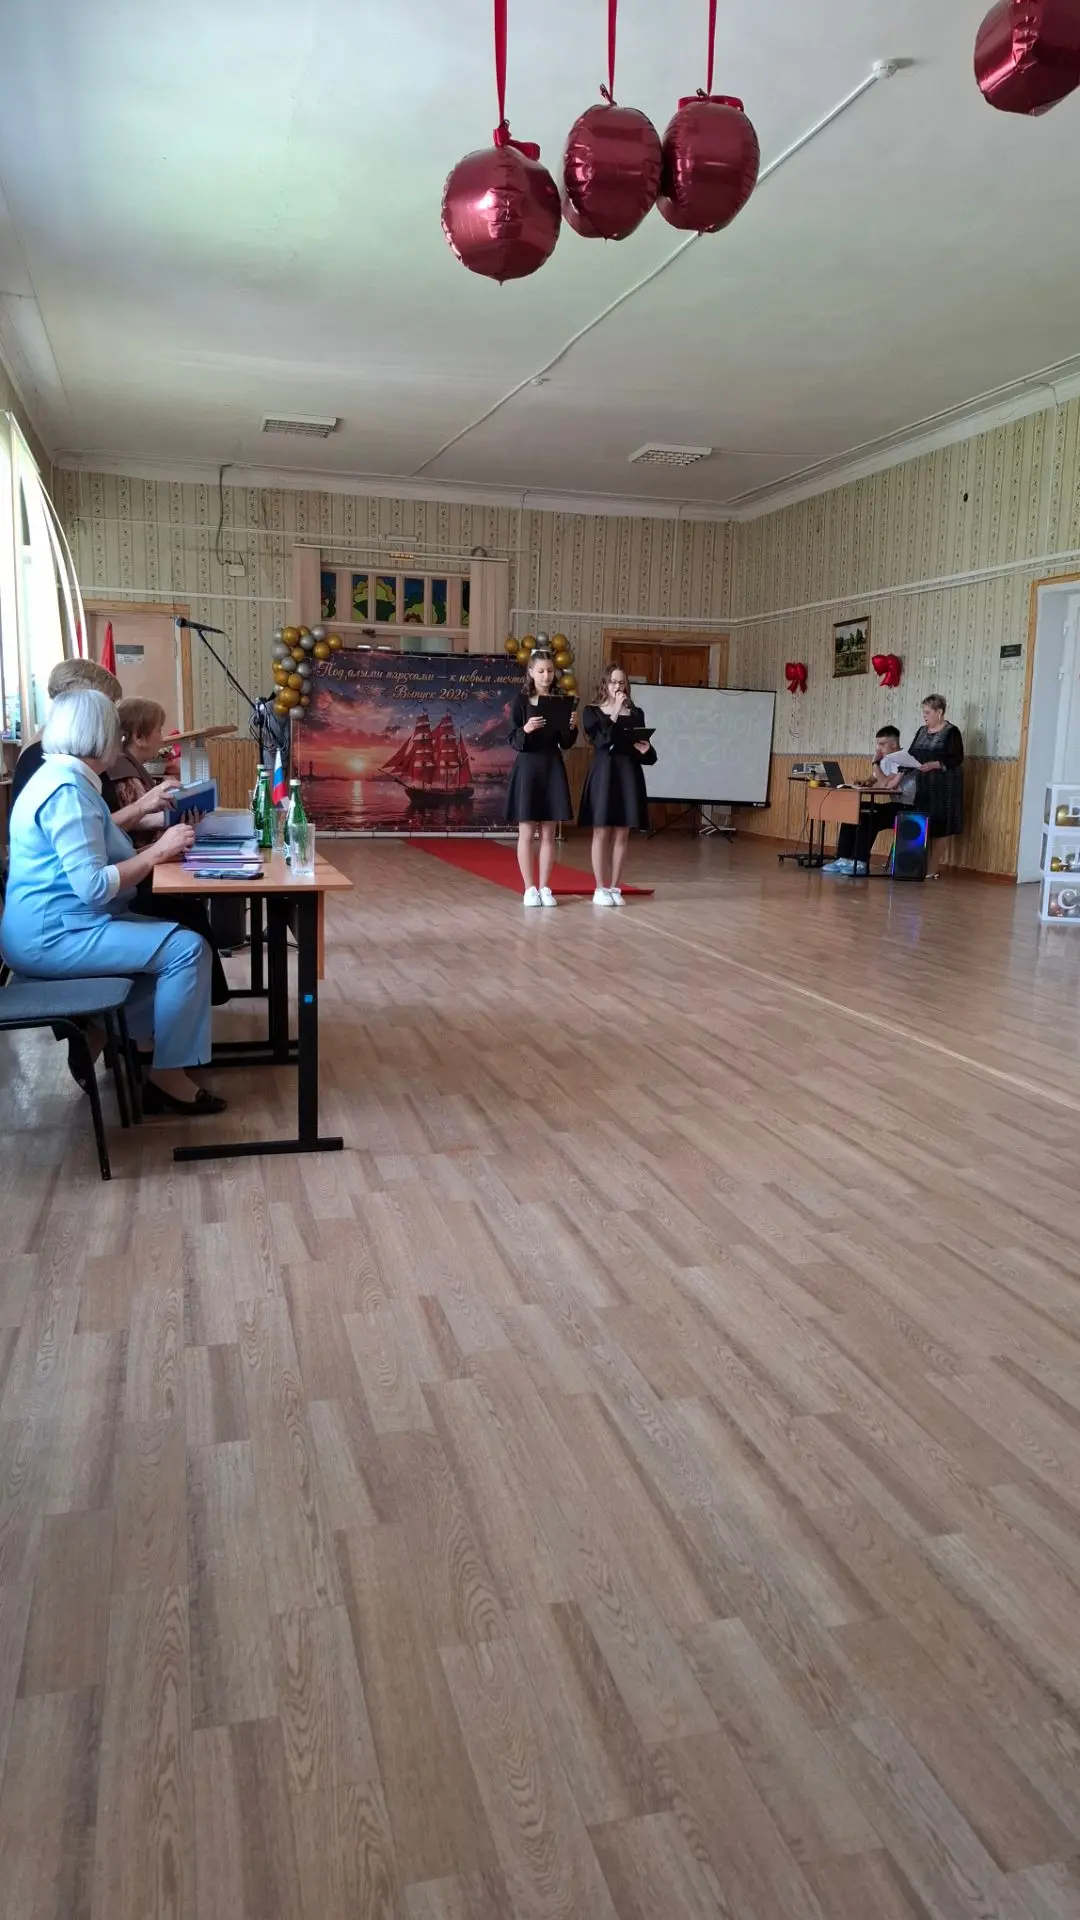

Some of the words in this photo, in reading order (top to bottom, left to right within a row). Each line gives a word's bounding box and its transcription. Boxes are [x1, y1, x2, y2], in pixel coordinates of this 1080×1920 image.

[316, 661, 344, 680] Под
[345, 669, 383, 680] алыми
[385, 671, 434, 684] парусами
[459, 669, 491, 683] новым
[494, 674, 525, 684] мечта
[393, 684, 436, 700] Выпуск
[439, 688, 469, 700] 2026
